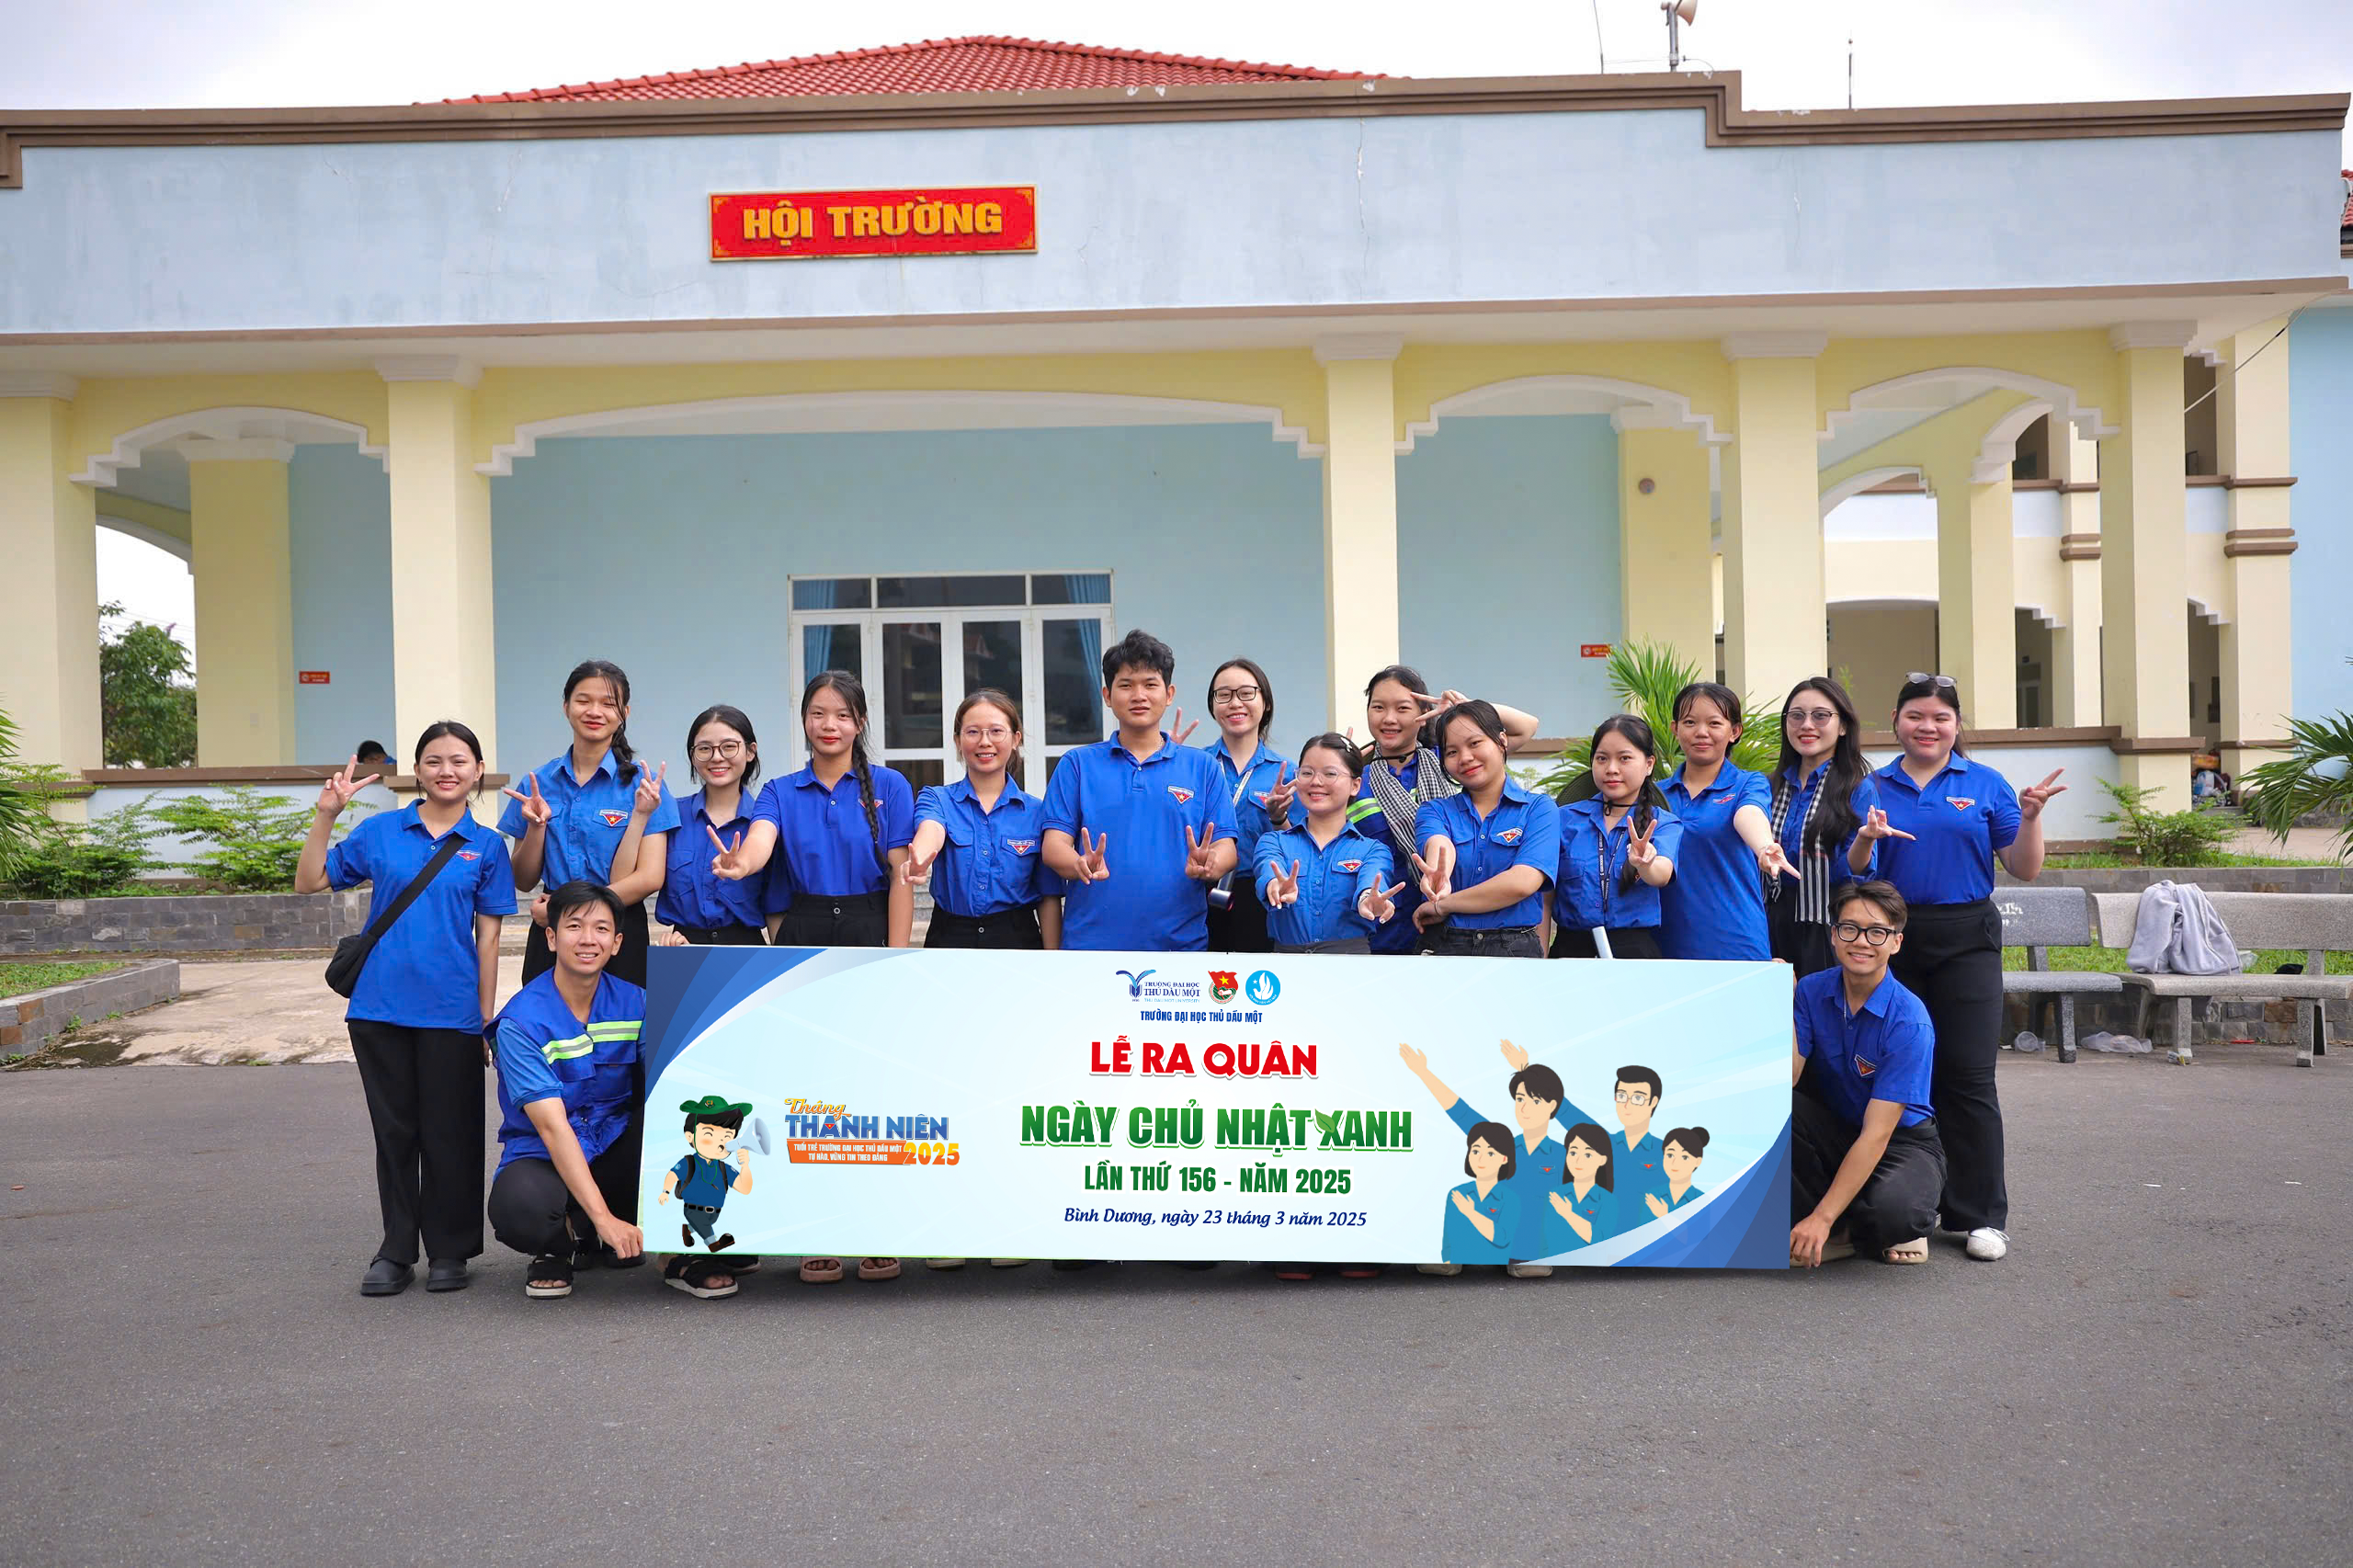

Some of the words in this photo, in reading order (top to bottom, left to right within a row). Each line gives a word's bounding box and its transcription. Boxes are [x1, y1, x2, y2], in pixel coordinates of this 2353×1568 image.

[743, 200, 813, 246] HỘI
[826, 196, 1003, 237] TRƯỜNG
[1143, 986, 1162, 996] THỦ
[1182, 987, 1200, 997] MỘT
[1141, 1008, 1172, 1021] TRƯỜNG
[1175, 1011, 1188, 1023] ĐẠI
[1190, 1011, 1206, 1024] HỌC
[1209, 1009, 1223, 1022] THỦ
[1245, 1010, 1263, 1024] MỘT
[1091, 1035, 1132, 1075] LỄ
[1142, 1042, 1194, 1075] RA
[1202, 1040, 1318, 1079] QUÂN
[784, 1097, 851, 1120] Tháng
[785, 1115, 880, 1139] THANH
[886, 1113, 949, 1140] NIÊN
[1020, 1100, 1120, 1146] NGÀY
[1128, 1098, 1204, 1148] CHỦ
[1215, 1103, 1312, 1155] NHẬT
[1315, 1108, 1413, 1151] XANH
[853, 1144, 864, 1153] HỌC
[904, 1142, 960, 1165] 2025
[1085, 1159, 1122, 1190] LẦN
[1130, 1160, 1172, 1191] THỨ
[1178, 1166, 1216, 1192] 156
[1240, 1162, 1288, 1193] NĂM
[1295, 1168, 1351, 1194] 2025
[1064, 1207, 1099, 1222] Bình
[1104, 1208, 1156, 1226] Dương,
[1161, 1210, 1199, 1227] ngày
[1203, 1210, 1222, 1224] 23
[1226, 1210, 1271, 1228] tháng
[1275, 1210, 1285, 1225] 3
[1289, 1211, 1324, 1226] năm
[1327, 1211, 1367, 1226] 2025
